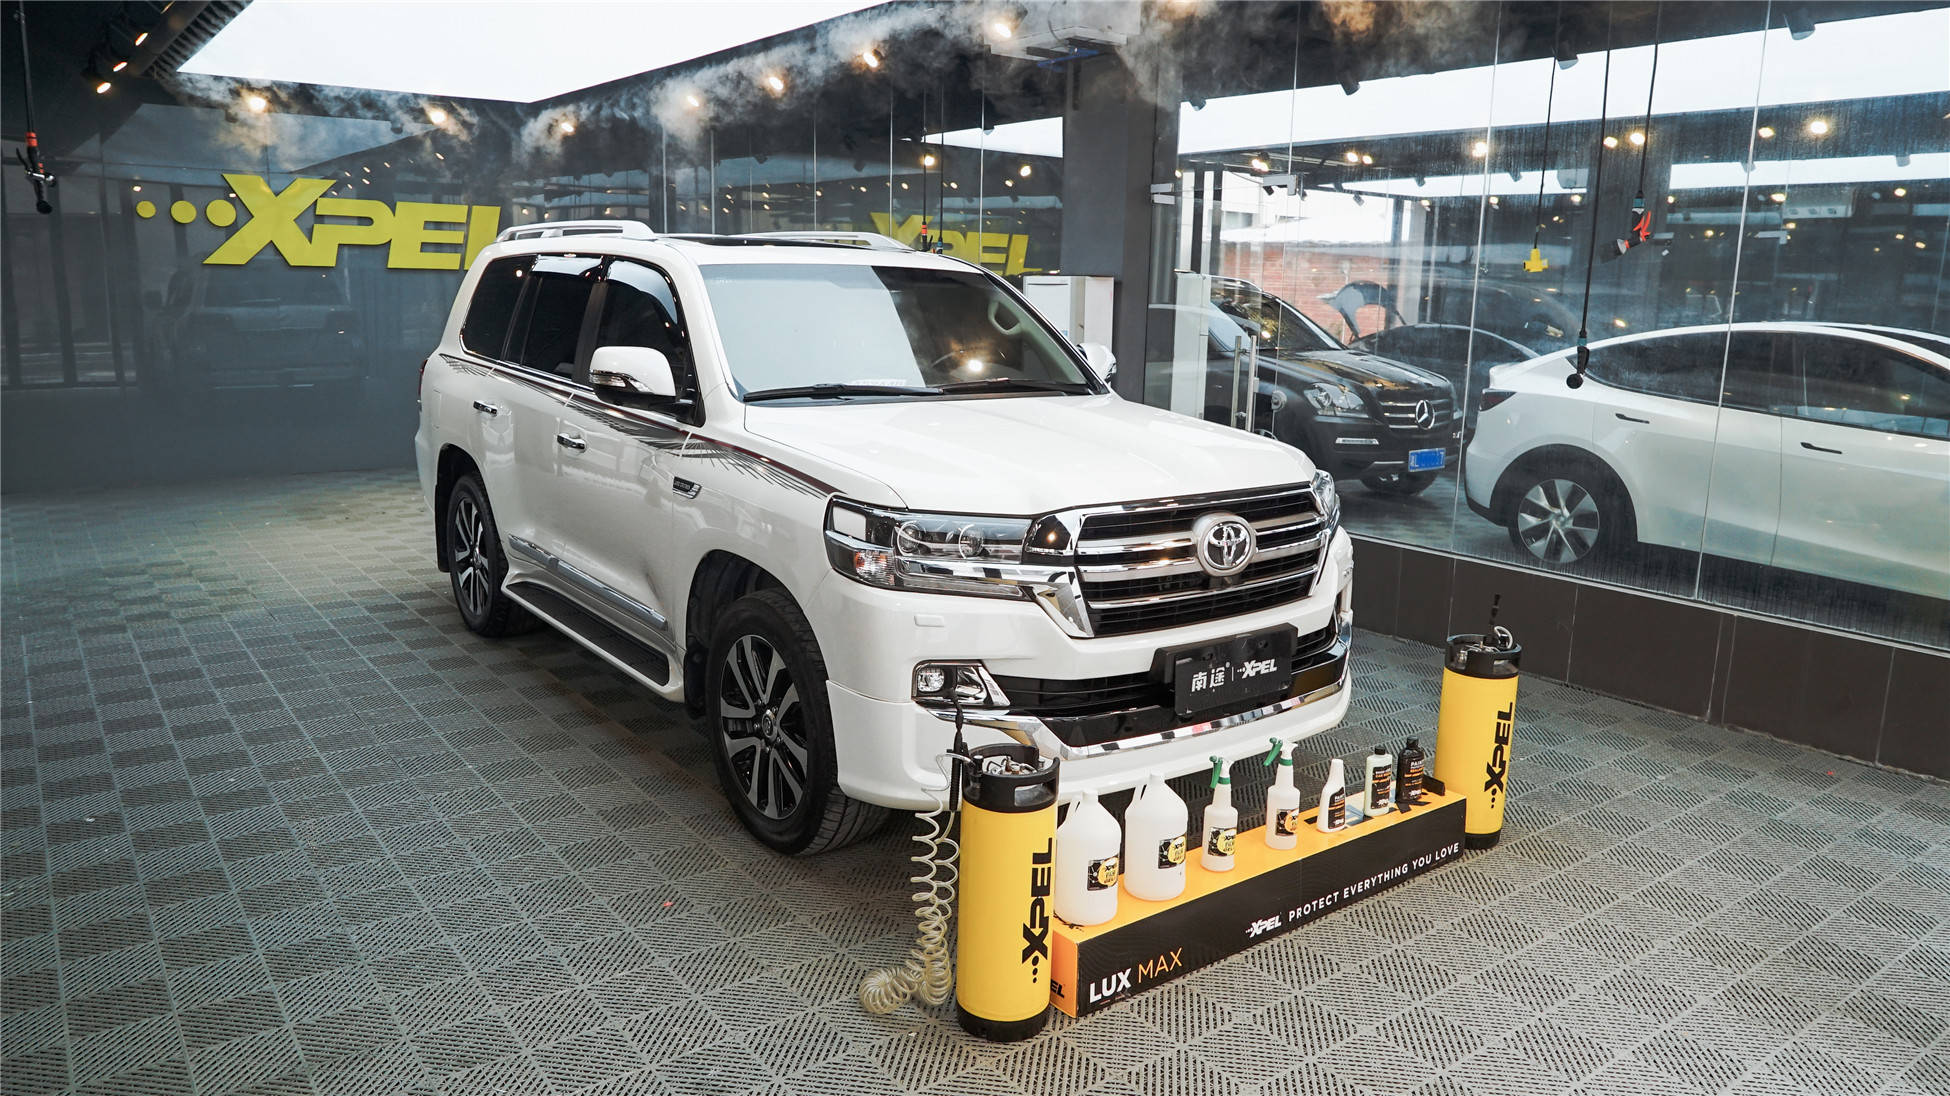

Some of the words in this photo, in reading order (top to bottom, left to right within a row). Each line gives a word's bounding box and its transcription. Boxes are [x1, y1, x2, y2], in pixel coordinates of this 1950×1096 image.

[1191, 667, 1225, 692] 南途
[1241, 659, 1277, 679] XPEL
[1484, 702, 1513, 794] XPEL
[1022, 838, 1052, 964] XPEL
[1249, 915, 1281, 938] XPEL
[1288, 892, 1339, 922] PROTECT
[1343, 863, 1408, 899] EVERYTHING
[1412, 853, 1432, 870] YOU
[1435, 842, 1459, 860] LOVE
[1050, 979, 1064, 998] EL
[1089, 968, 1131, 1003] LUX
[1138, 947, 1182, 983] MAX
